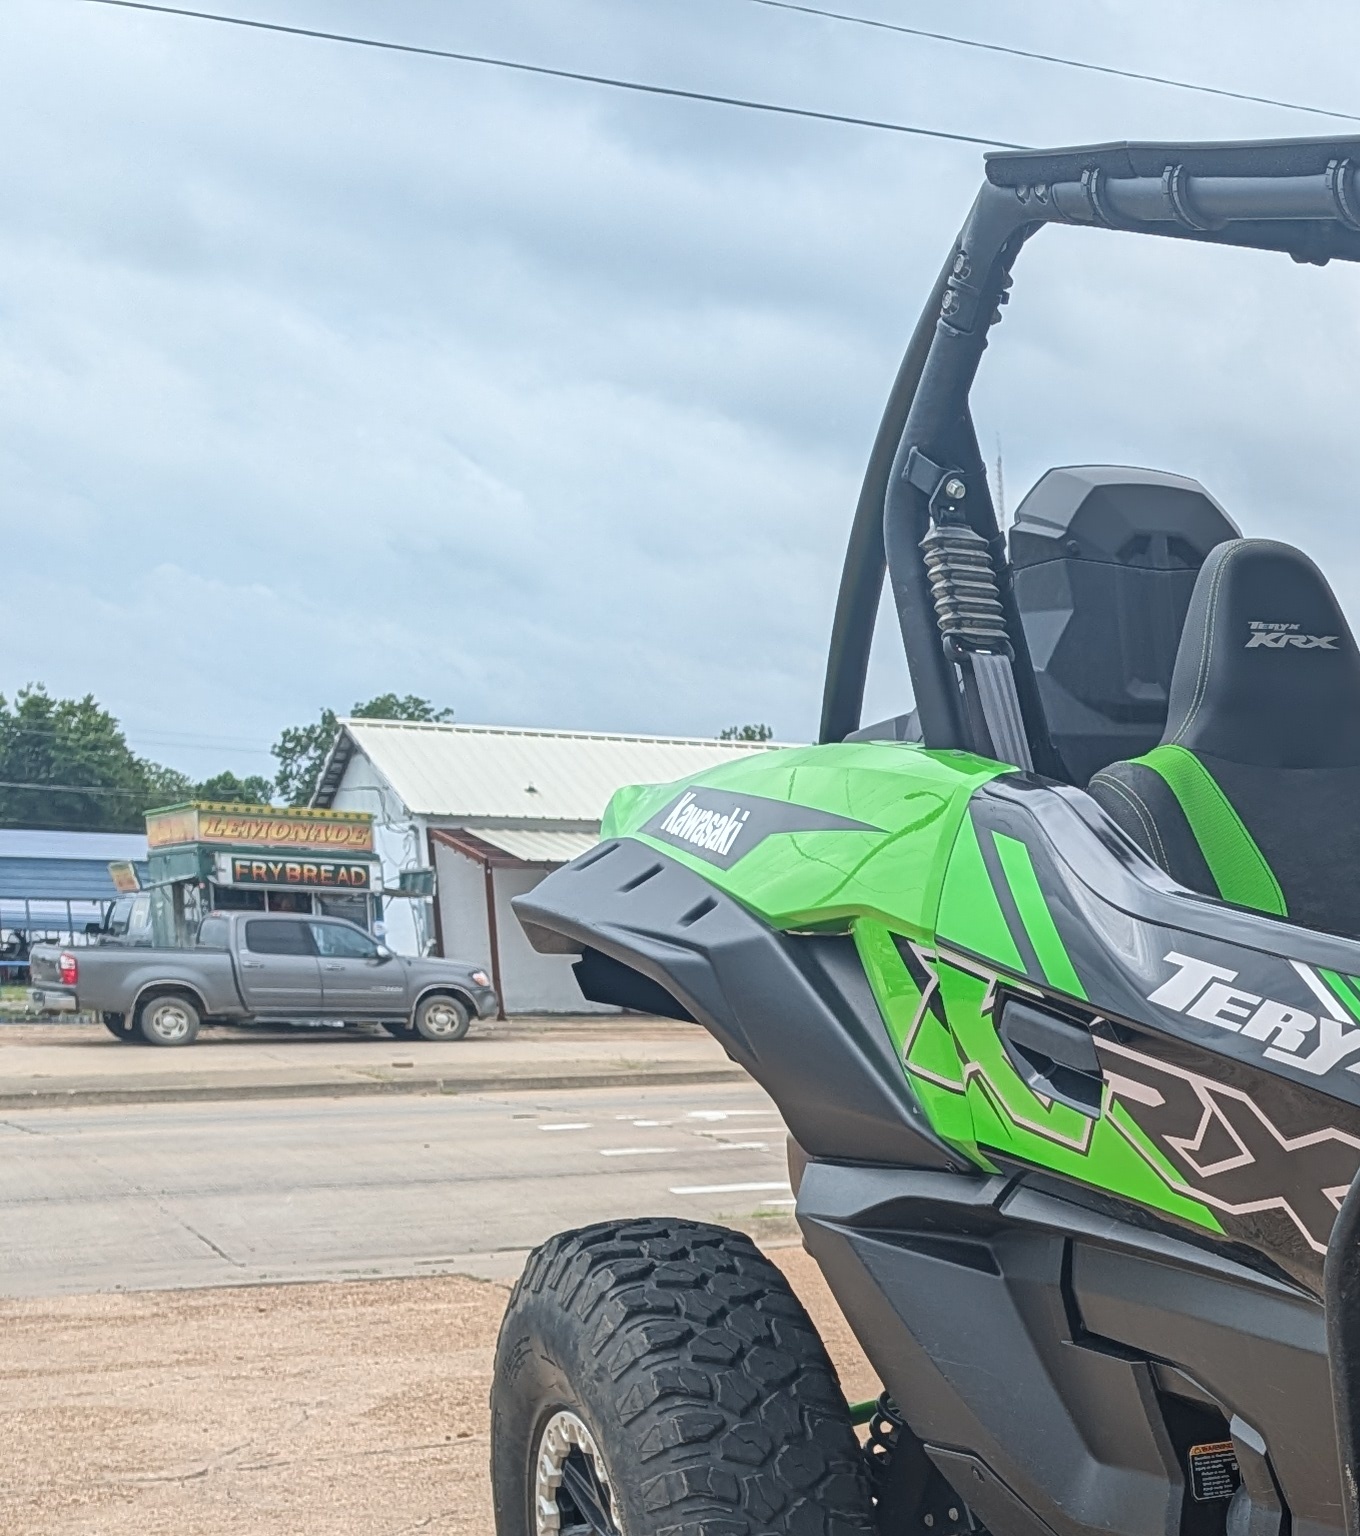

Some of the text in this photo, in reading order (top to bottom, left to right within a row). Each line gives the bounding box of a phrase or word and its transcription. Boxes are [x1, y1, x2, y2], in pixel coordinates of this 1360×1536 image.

[1244, 631, 1341, 650] KRX
[204, 816, 371, 846] LEMONADE
[660, 791, 751, 856] Kawasaki
[234, 859, 368, 887] FRYBREAD
